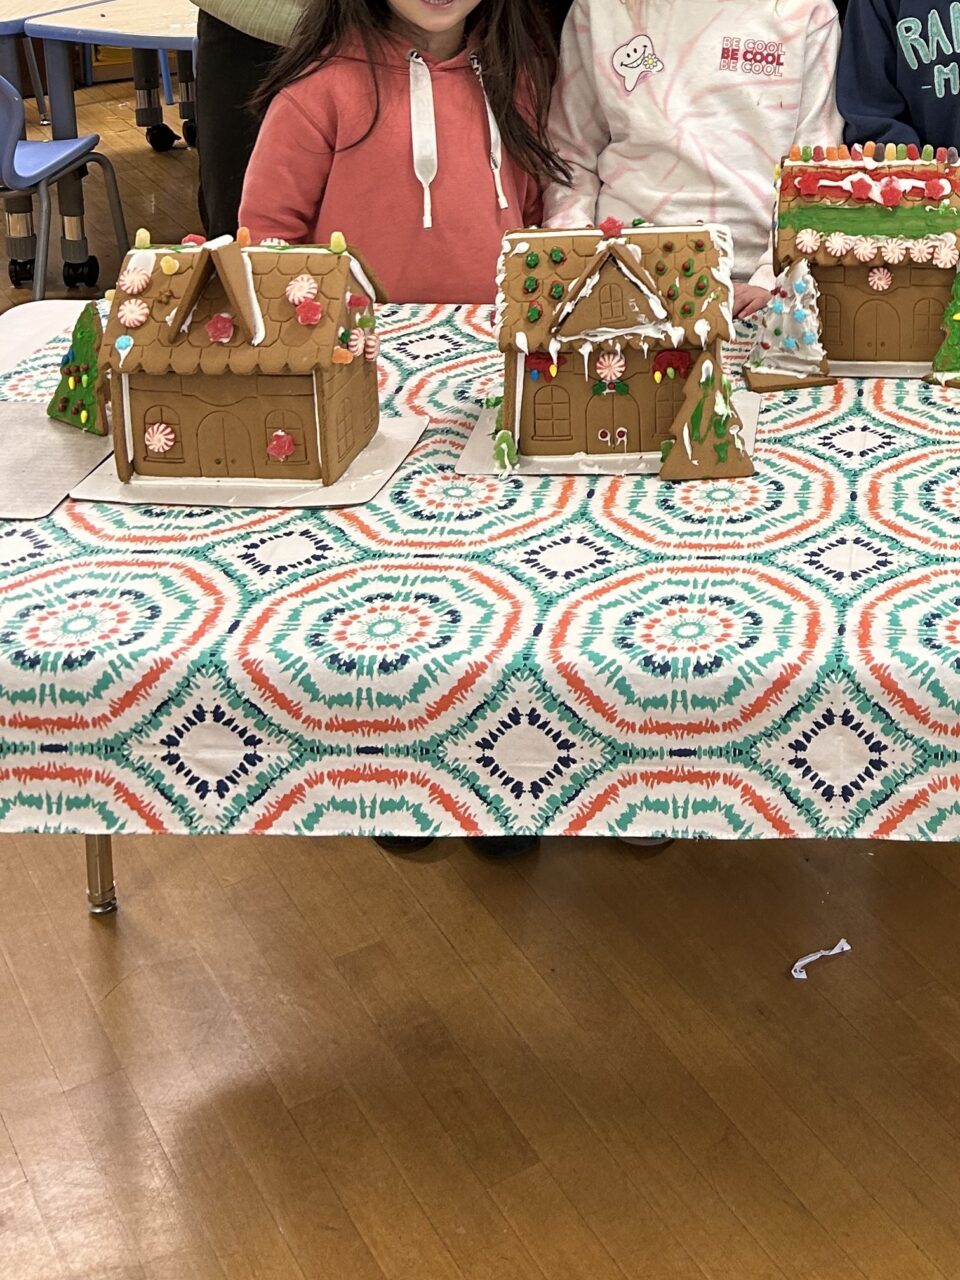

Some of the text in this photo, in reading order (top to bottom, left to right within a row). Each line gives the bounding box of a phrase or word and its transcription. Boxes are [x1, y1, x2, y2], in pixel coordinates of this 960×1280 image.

[722, 36, 786, 55] BE COOL
[721, 47, 784, 66] BE COOL
[719, 58, 783, 77] BE COOL
